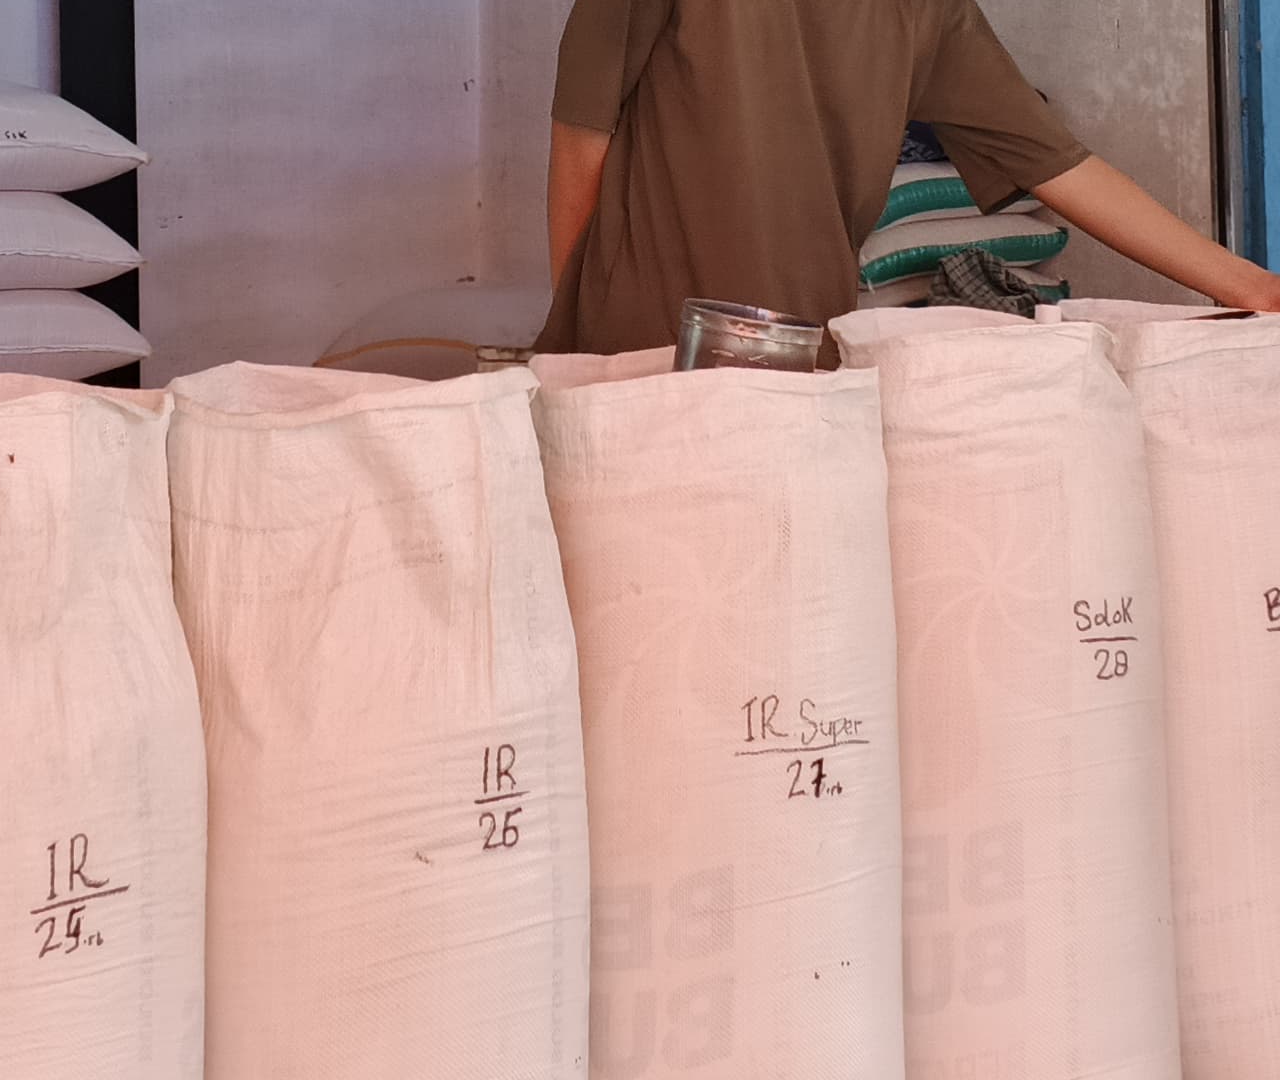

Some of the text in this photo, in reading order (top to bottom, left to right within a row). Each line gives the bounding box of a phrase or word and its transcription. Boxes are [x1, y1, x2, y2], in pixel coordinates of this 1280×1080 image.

[1094, 648, 1129, 681] 28
[741, 694, 863, 746] IR Super
[483, 744, 517, 794] IR
[46, 833, 110, 901] IR
